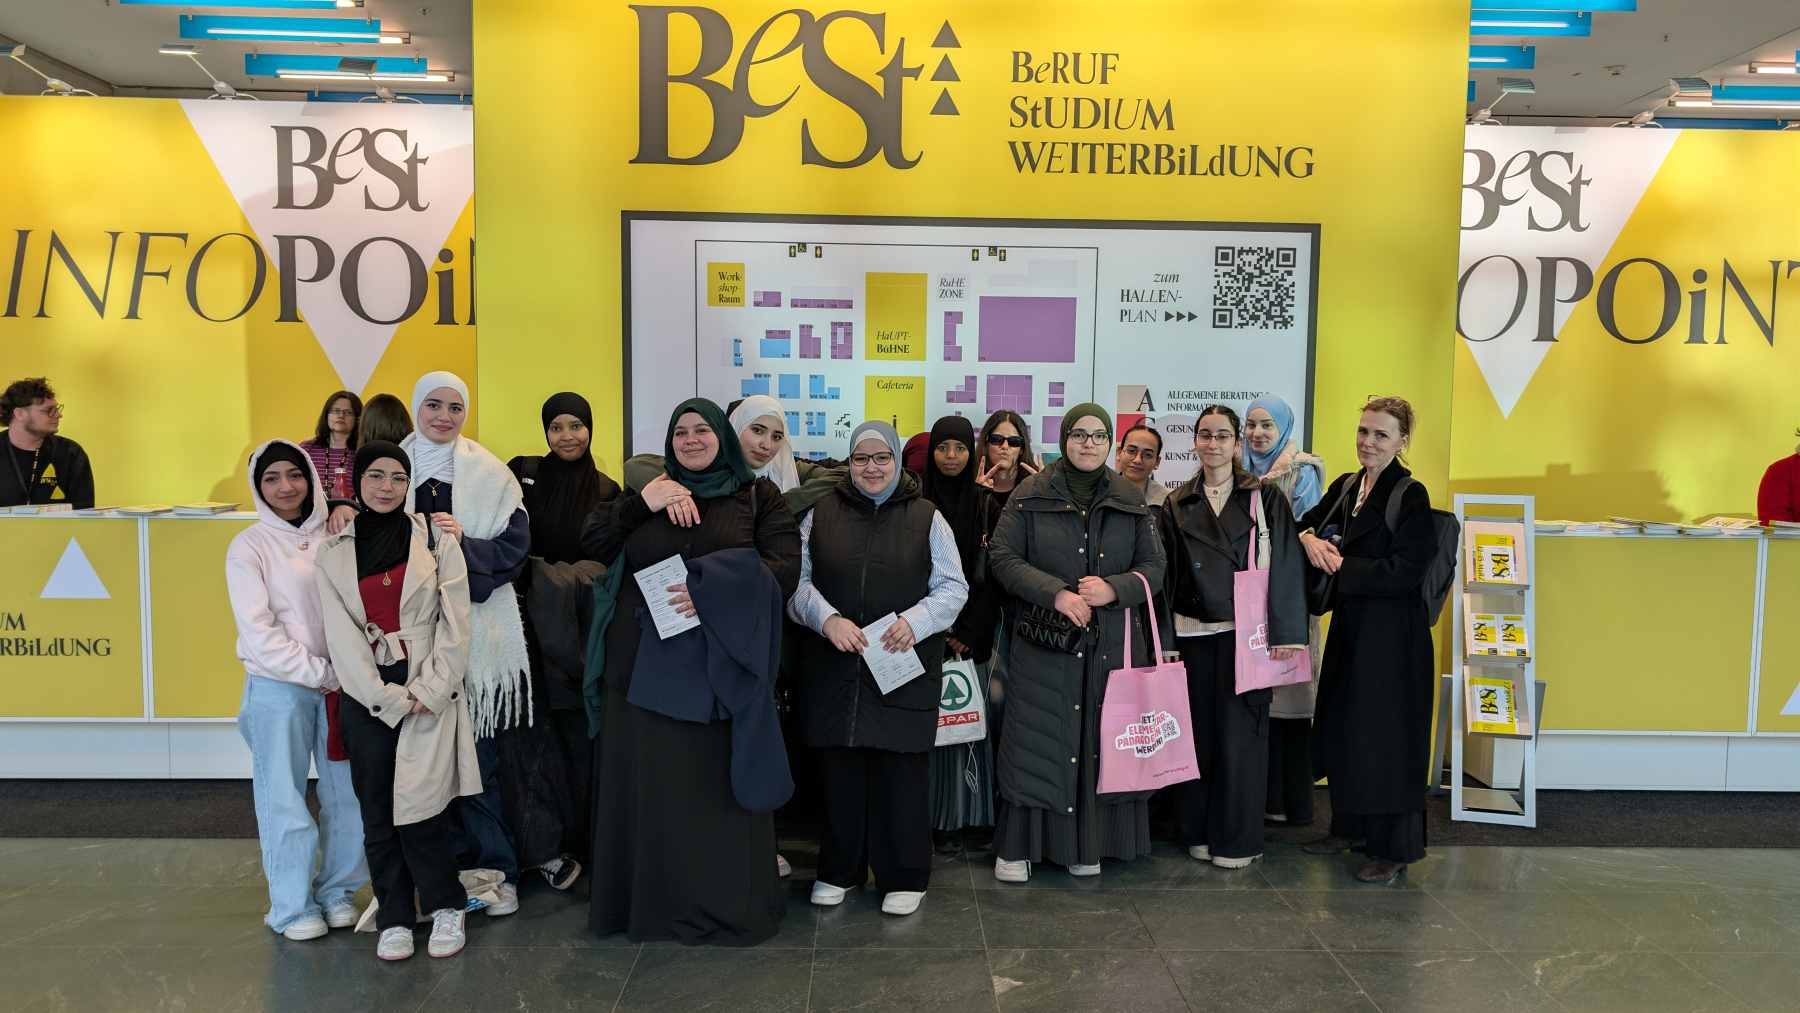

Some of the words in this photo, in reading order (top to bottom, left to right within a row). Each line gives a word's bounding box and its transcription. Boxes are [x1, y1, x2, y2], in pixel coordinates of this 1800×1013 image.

[1010, 51, 1119, 85] BeRUF
[628, 4, 925, 169] BeSt
[1009, 96, 1175, 131] StUDIUM
[1008, 140, 1314, 178] WEITERBiLdUNG
[271, 125, 430, 212] BeSt
[0, 229, 475, 326] INFOPOi
[1152, 273, 1180, 283] zum
[718, 294, 741, 304] Raum
[938, 288, 964, 299] ZONE
[1120, 289, 1182, 303] HALLEN-
[1120, 309, 1157, 322] PLAN
[876, 380, 914, 391] Cafeteria
[1167, 391, 1218, 400] ALLGEMEINE
[1167, 402, 1212, 412] INFORMAT
[1166, 424, 1194, 434] GESUN
[1164, 451, 1192, 462] KUNST
[1164, 480, 1185, 489] MED
[938, 713, 978, 726] SPAR
